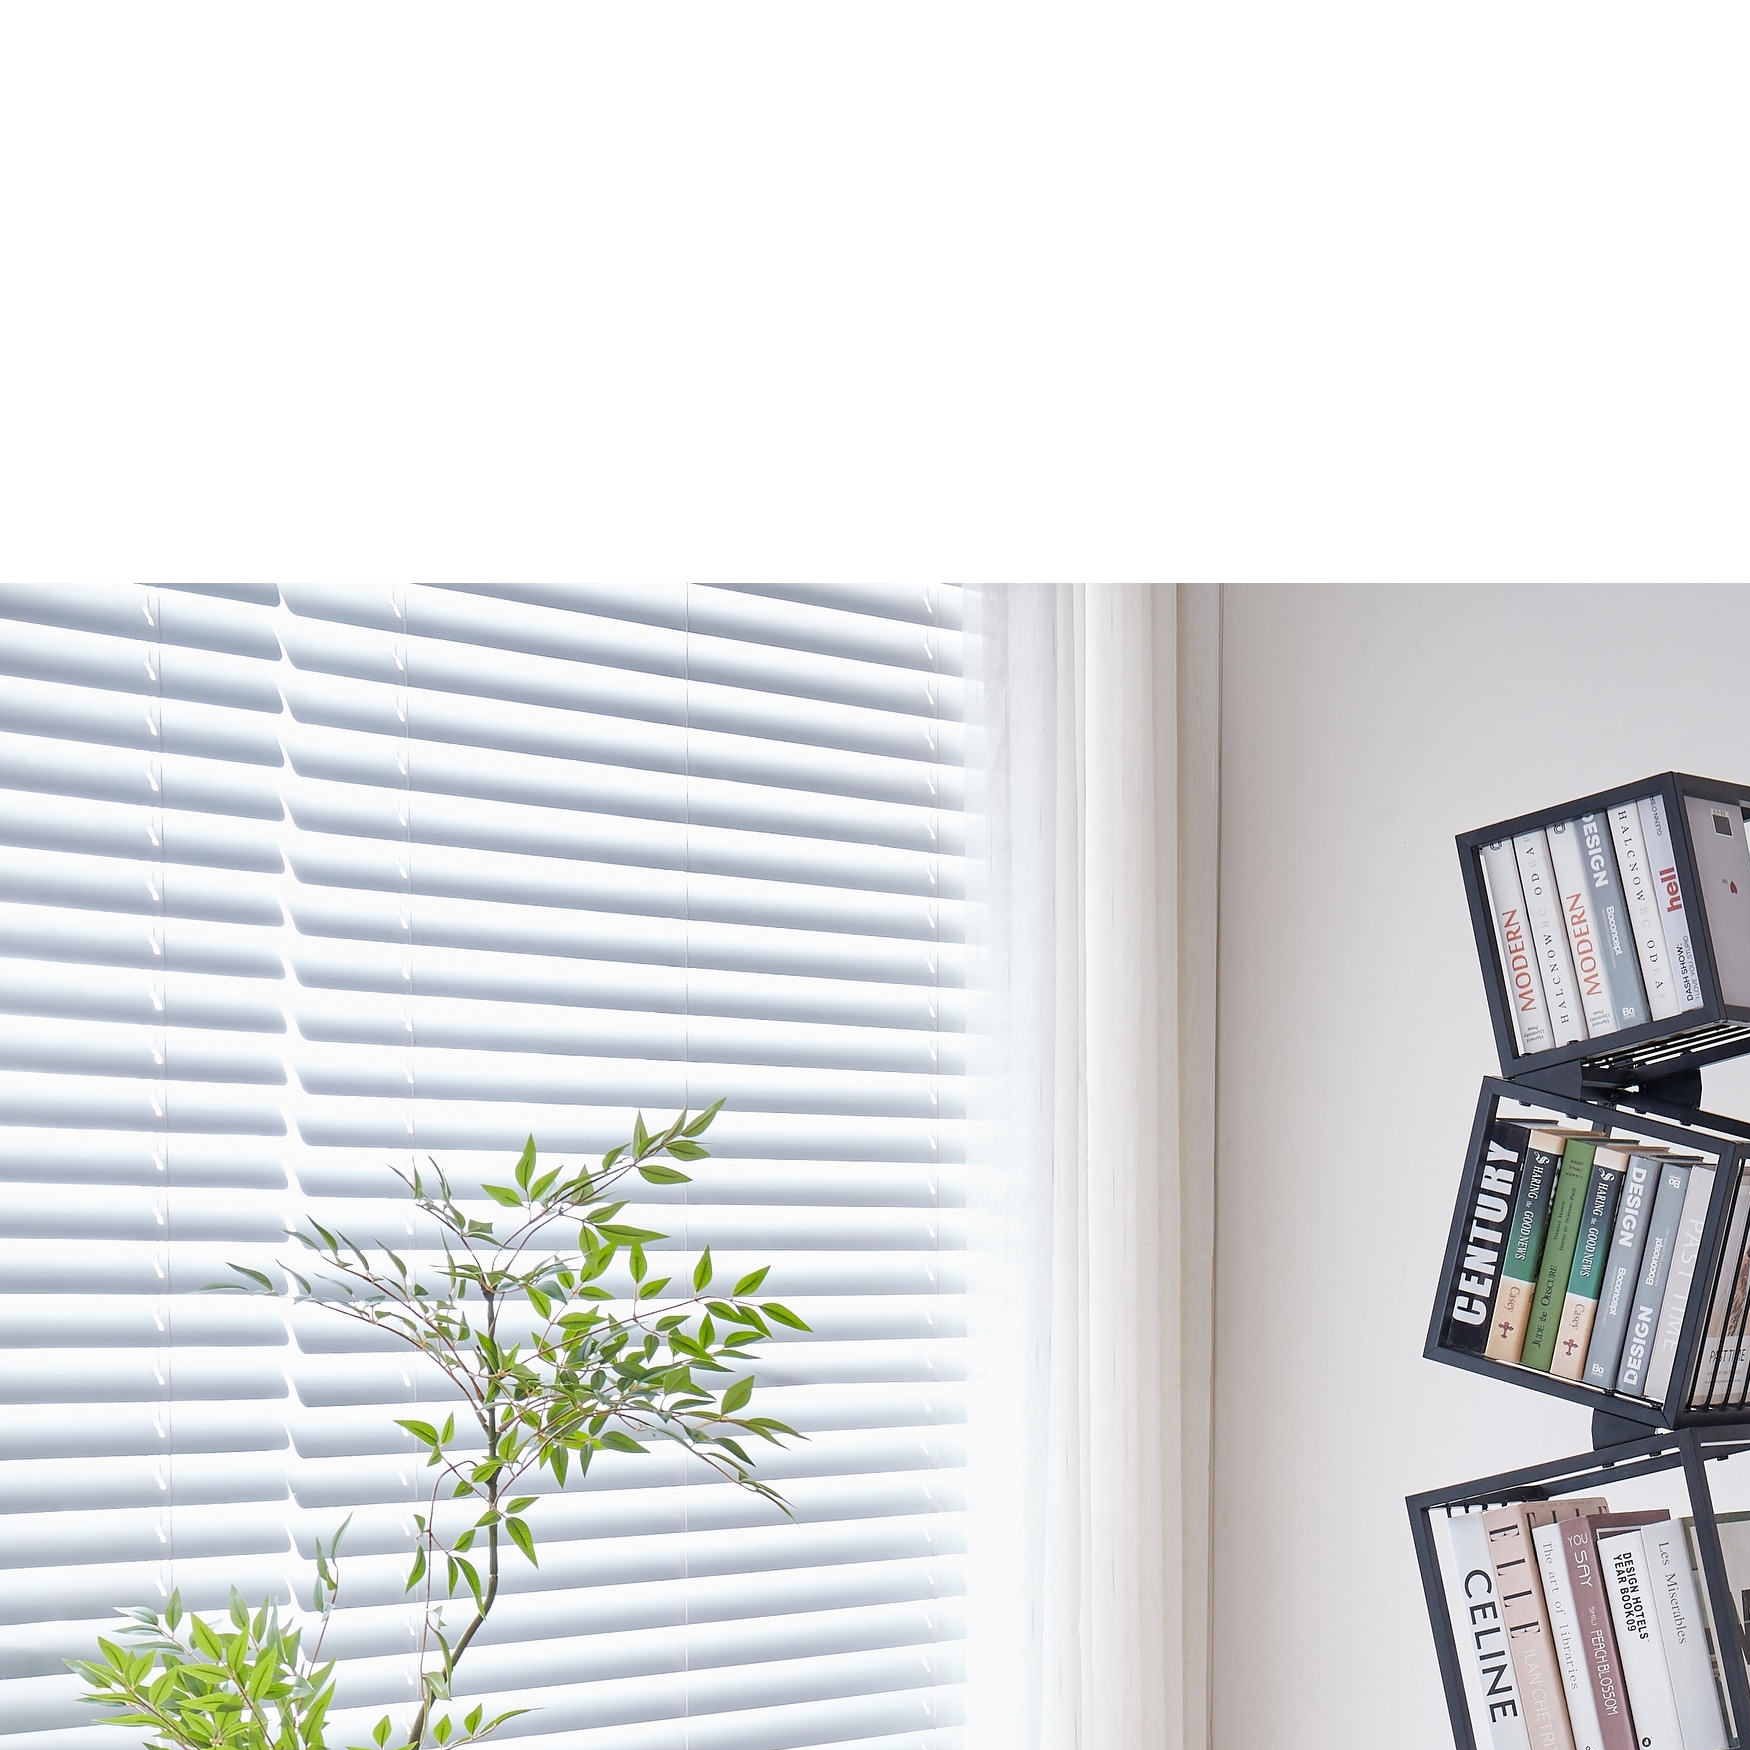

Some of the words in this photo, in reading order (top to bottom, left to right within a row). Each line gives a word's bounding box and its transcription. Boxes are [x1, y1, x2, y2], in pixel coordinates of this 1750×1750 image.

[1659, 867, 1683, 913] hell
[1566, 893, 1602, 996] MODERN
[1606, 905, 1624, 956] Boconcept
[1502, 909, 1537, 1011] MODERN
[1682, 976, 1694, 1002] DASH
[1622, 1006, 1636, 1017] Bo
[1668, 1178, 1681, 1189] Bo
[1520, 1210, 1534, 1239] GOOD
[1618, 1167, 1648, 1248] DESIGN
[1452, 1140, 1519, 1326] CENTURY
[1515, 1235, 1529, 1261] NEWS
[1585, 1227, 1599, 1254] GOOD
[1579, 1250, 1593, 1277] NEWS
[1645, 1237, 1664, 1286] Boconcept
[1503, 1286, 1521, 1313] Casey
[1541, 1264, 1558, 1307] OBSCURE
[1609, 1267, 1627, 1316] Boconcept
[1540, 1311, 1548, 1322] the
[1568, 1303, 1586, 1330] Casey
[1532, 1325, 1545, 1348] JUDE
[1623, 1305, 1654, 1386] DESIGN
[1591, 1363, 1605, 1375] Bo
[1542, 1541, 1553, 1565] The
[1567, 1533, 1588, 1548] YOU
[1489, 1524, 1541, 1639] ELLE
[1548, 1571, 1560, 1593] art
[1574, 1550, 1594, 1588] SAY
[1613, 1553, 1627, 1584] YEAR
[1622, 1551, 1640, 1594] DESIGN
[1555, 1601, 1567, 1616] of
[1658, 1541, 1671, 1566] Les
[1665, 1572, 1688, 1645] Miserables
[1464, 1569, 1518, 1723] CELINE
[1559, 1623, 1579, 1690] libraries
[1590, 1629, 1608, 1666] PEACH
[1597, 1664, 1619, 1716] BLOSSOM
